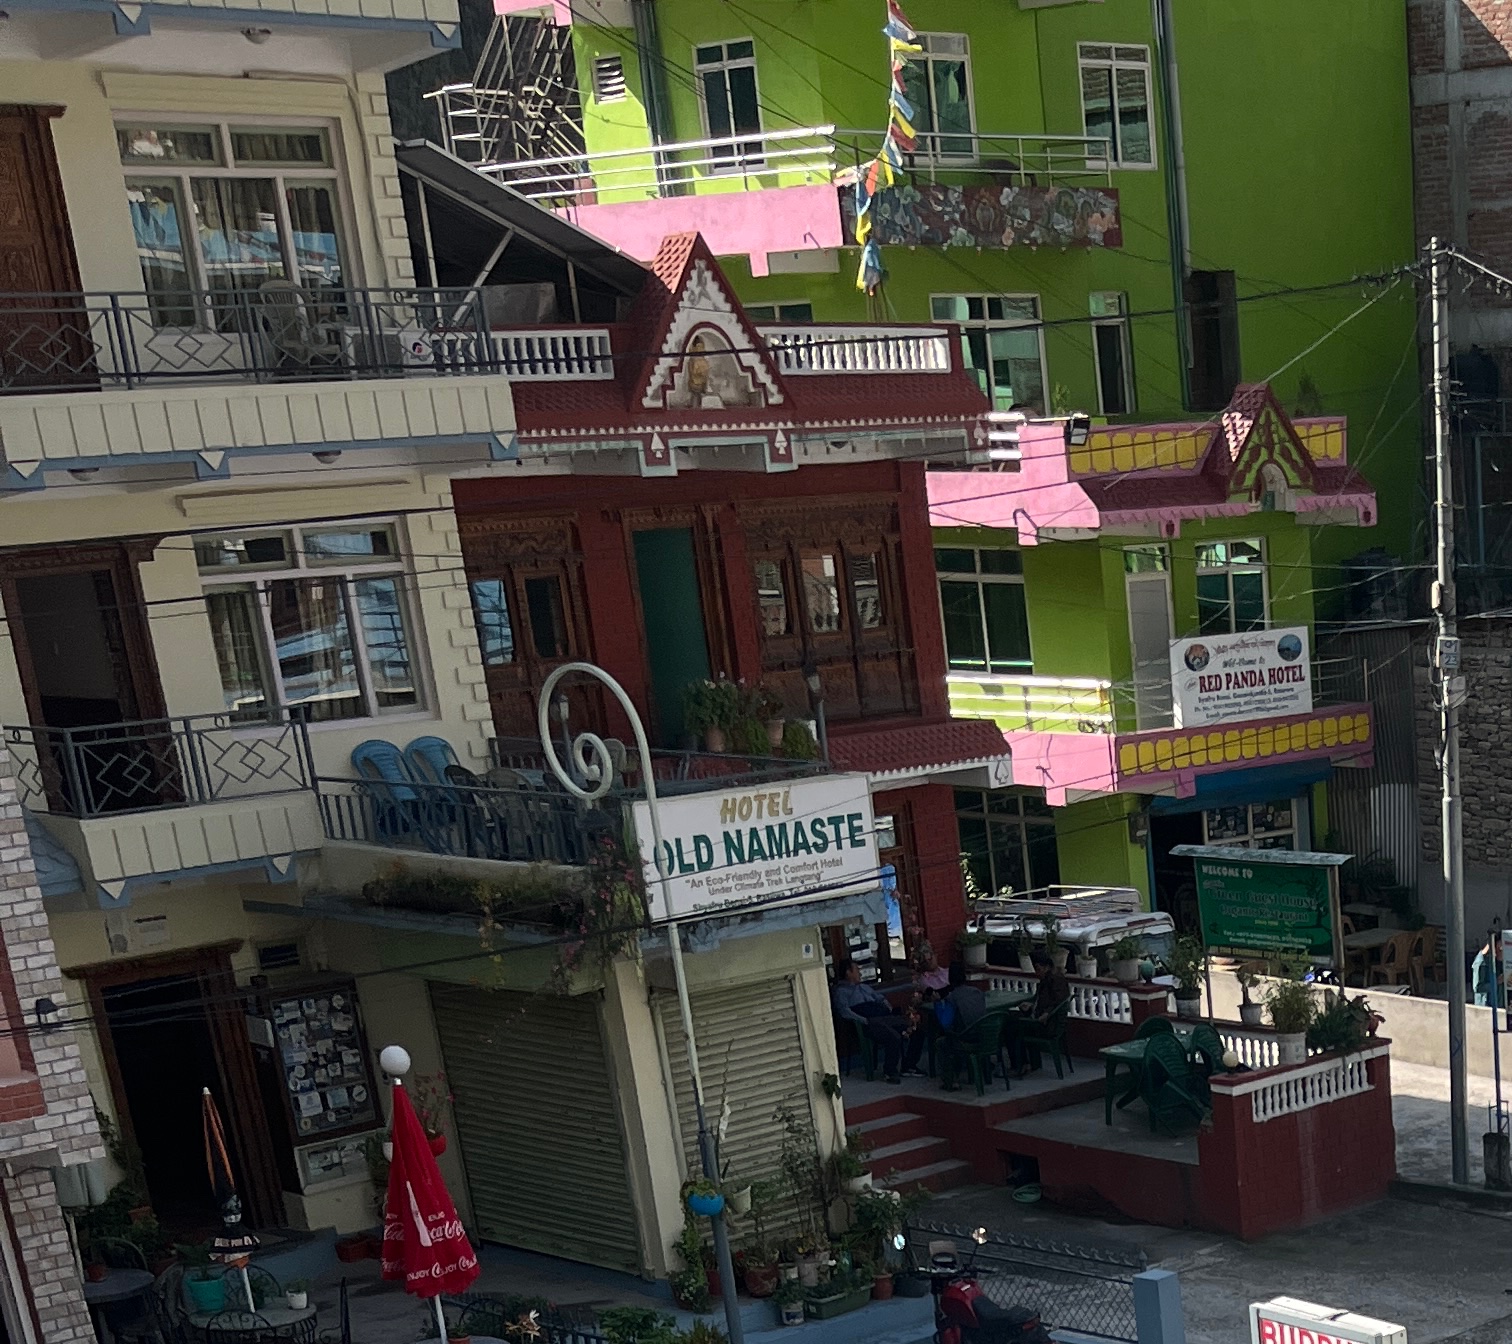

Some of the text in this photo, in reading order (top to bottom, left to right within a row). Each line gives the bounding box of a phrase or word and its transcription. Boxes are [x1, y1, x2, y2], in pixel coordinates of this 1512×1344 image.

[1199, 674, 1222, 693] RED
[1225, 669, 1265, 690] PANDA
[1268, 665, 1305, 685] HOTEL
[720, 791, 794, 825] HOTEL
[653, 812, 866, 876] OLD NAMASTE
[705, 867, 762, 887] Eco-Friendly
[784, 861, 819, 875] Comfort
[820, 856, 843, 868] Hotel
[1202, 865, 1253, 879] WELCOME TO
